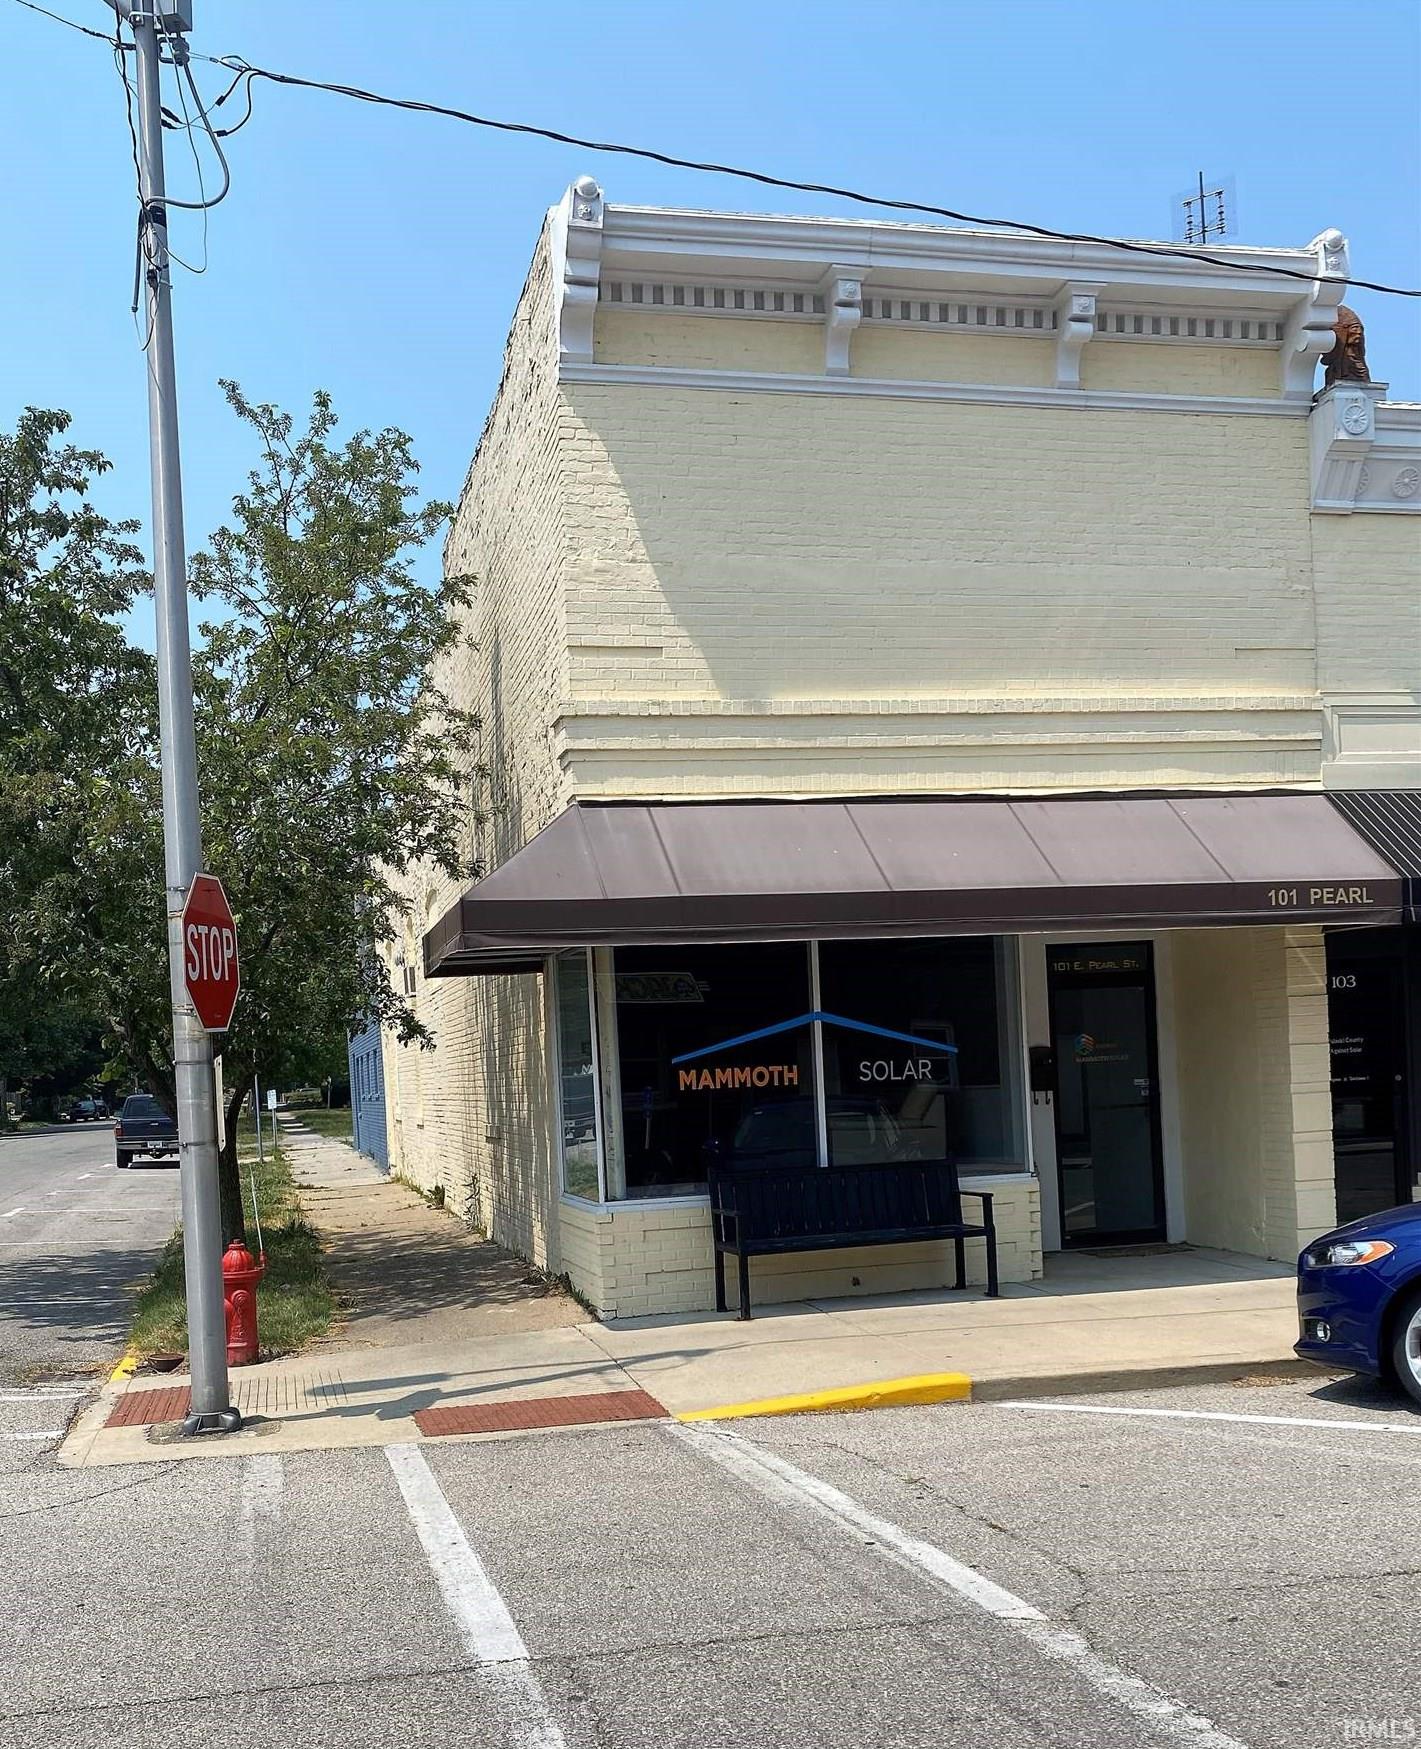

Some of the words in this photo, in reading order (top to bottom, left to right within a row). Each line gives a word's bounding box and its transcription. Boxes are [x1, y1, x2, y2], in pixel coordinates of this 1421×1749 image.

[1268, 889, 1298, 906] 101
[1310, 887, 1374, 905] PEARL
[187, 923, 234, 982] STOP
[1053, 961, 1071, 972] 101
[1332, 975, 1357, 989] 103
[679, 1065, 798, 1091] MAMMOTH
[859, 1059, 932, 1081] SOLAR
